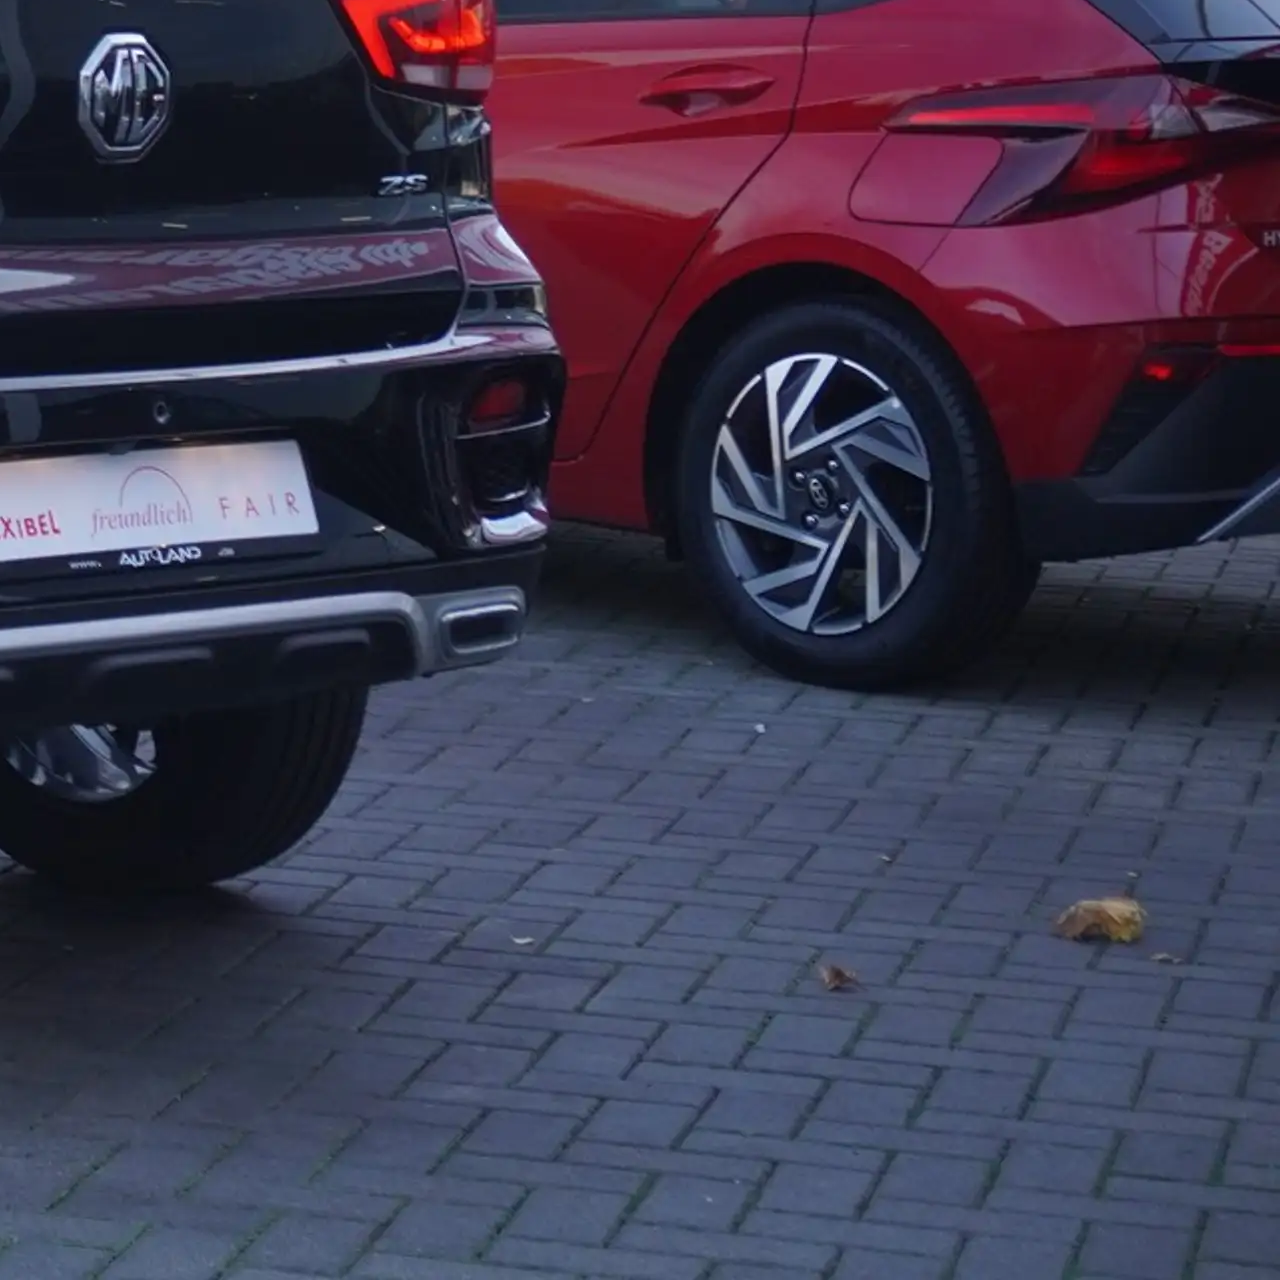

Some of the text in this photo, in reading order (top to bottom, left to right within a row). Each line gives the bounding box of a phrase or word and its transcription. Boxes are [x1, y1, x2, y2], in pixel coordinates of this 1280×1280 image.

[90, 46, 167, 147] MG
[378, 174, 428, 195] ZS
[90, 499, 188, 539] freundlich
[218, 491, 300, 520] FAIR
[119, 545, 202, 568] AUTOLAND
